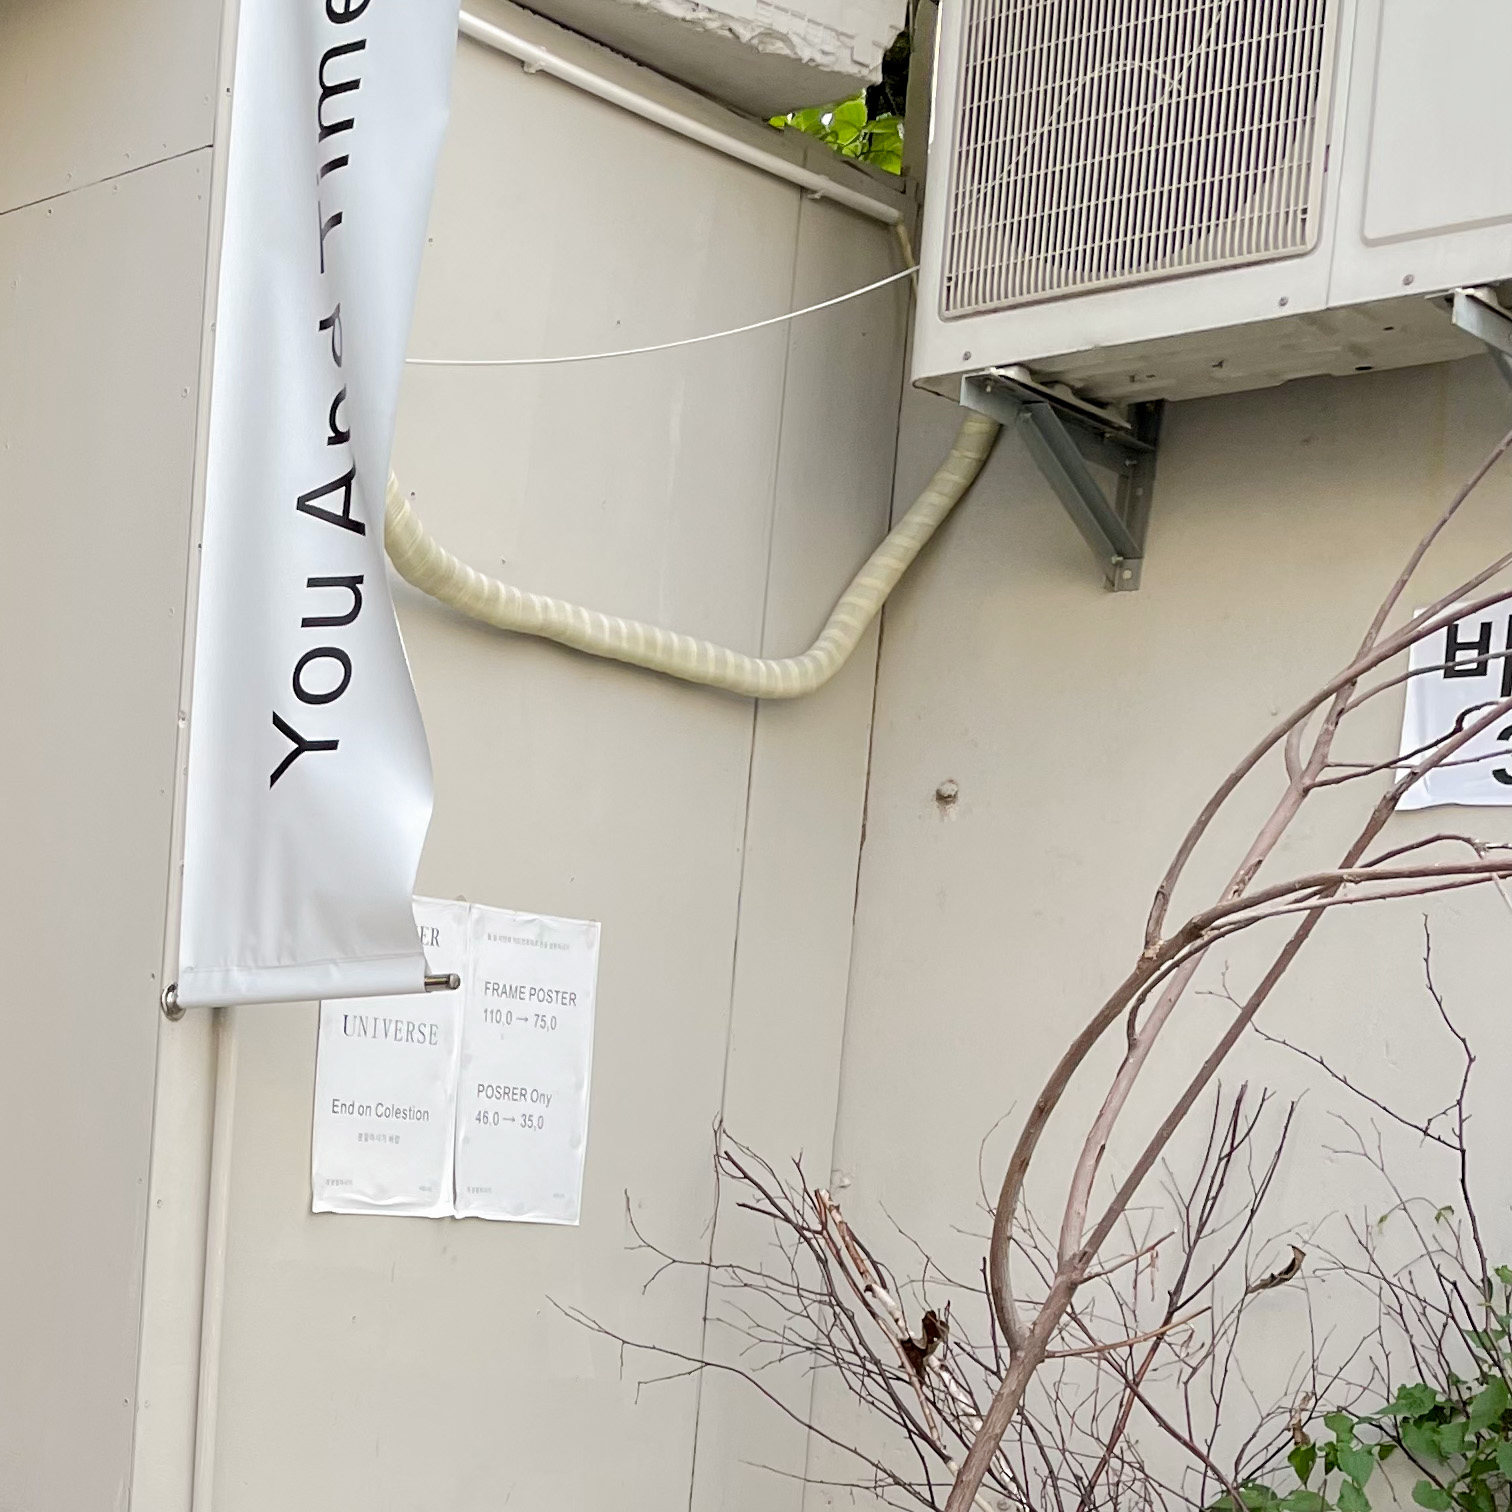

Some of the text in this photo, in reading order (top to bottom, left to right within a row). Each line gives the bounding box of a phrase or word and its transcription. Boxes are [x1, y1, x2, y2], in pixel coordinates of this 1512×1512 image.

[270, 574, 365, 790] You
[484, 981, 578, 1007] FRAME POSTER
[343, 1014, 439, 1046] UNIVERSE
[331, 1098, 355, 1115] End
[357, 1104, 372, 1117] on
